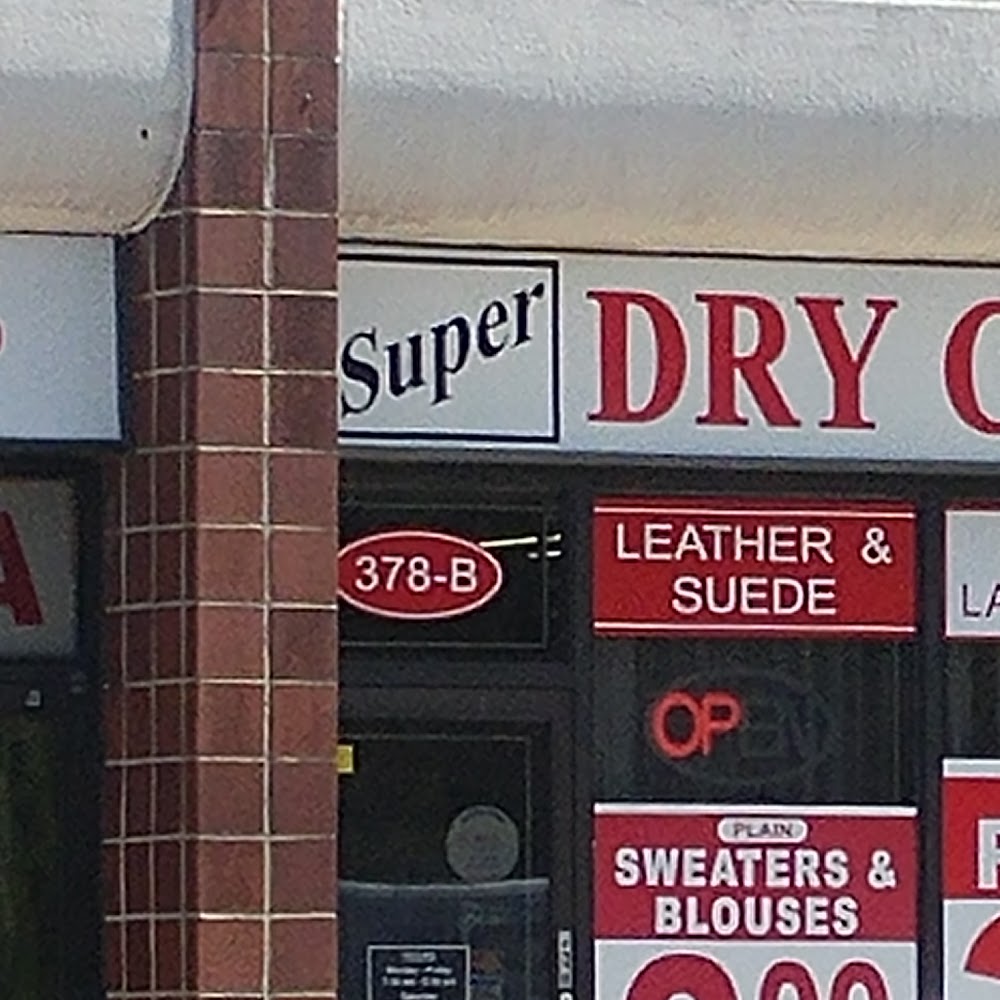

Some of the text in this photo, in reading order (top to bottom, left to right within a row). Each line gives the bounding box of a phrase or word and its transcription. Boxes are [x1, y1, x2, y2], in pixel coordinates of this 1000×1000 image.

[340, 282, 544, 416] Super
[586, 290, 898, 429] DRY
[616, 523, 893, 565] LEATHER &
[354, 555, 479, 595] 378-B
[672, 576, 837, 616] SUEDE
[732, 822, 793, 838] PLAIN
[614, 847, 897, 889] SWEATERS &
[654, 896, 859, 936] BLOUSES
